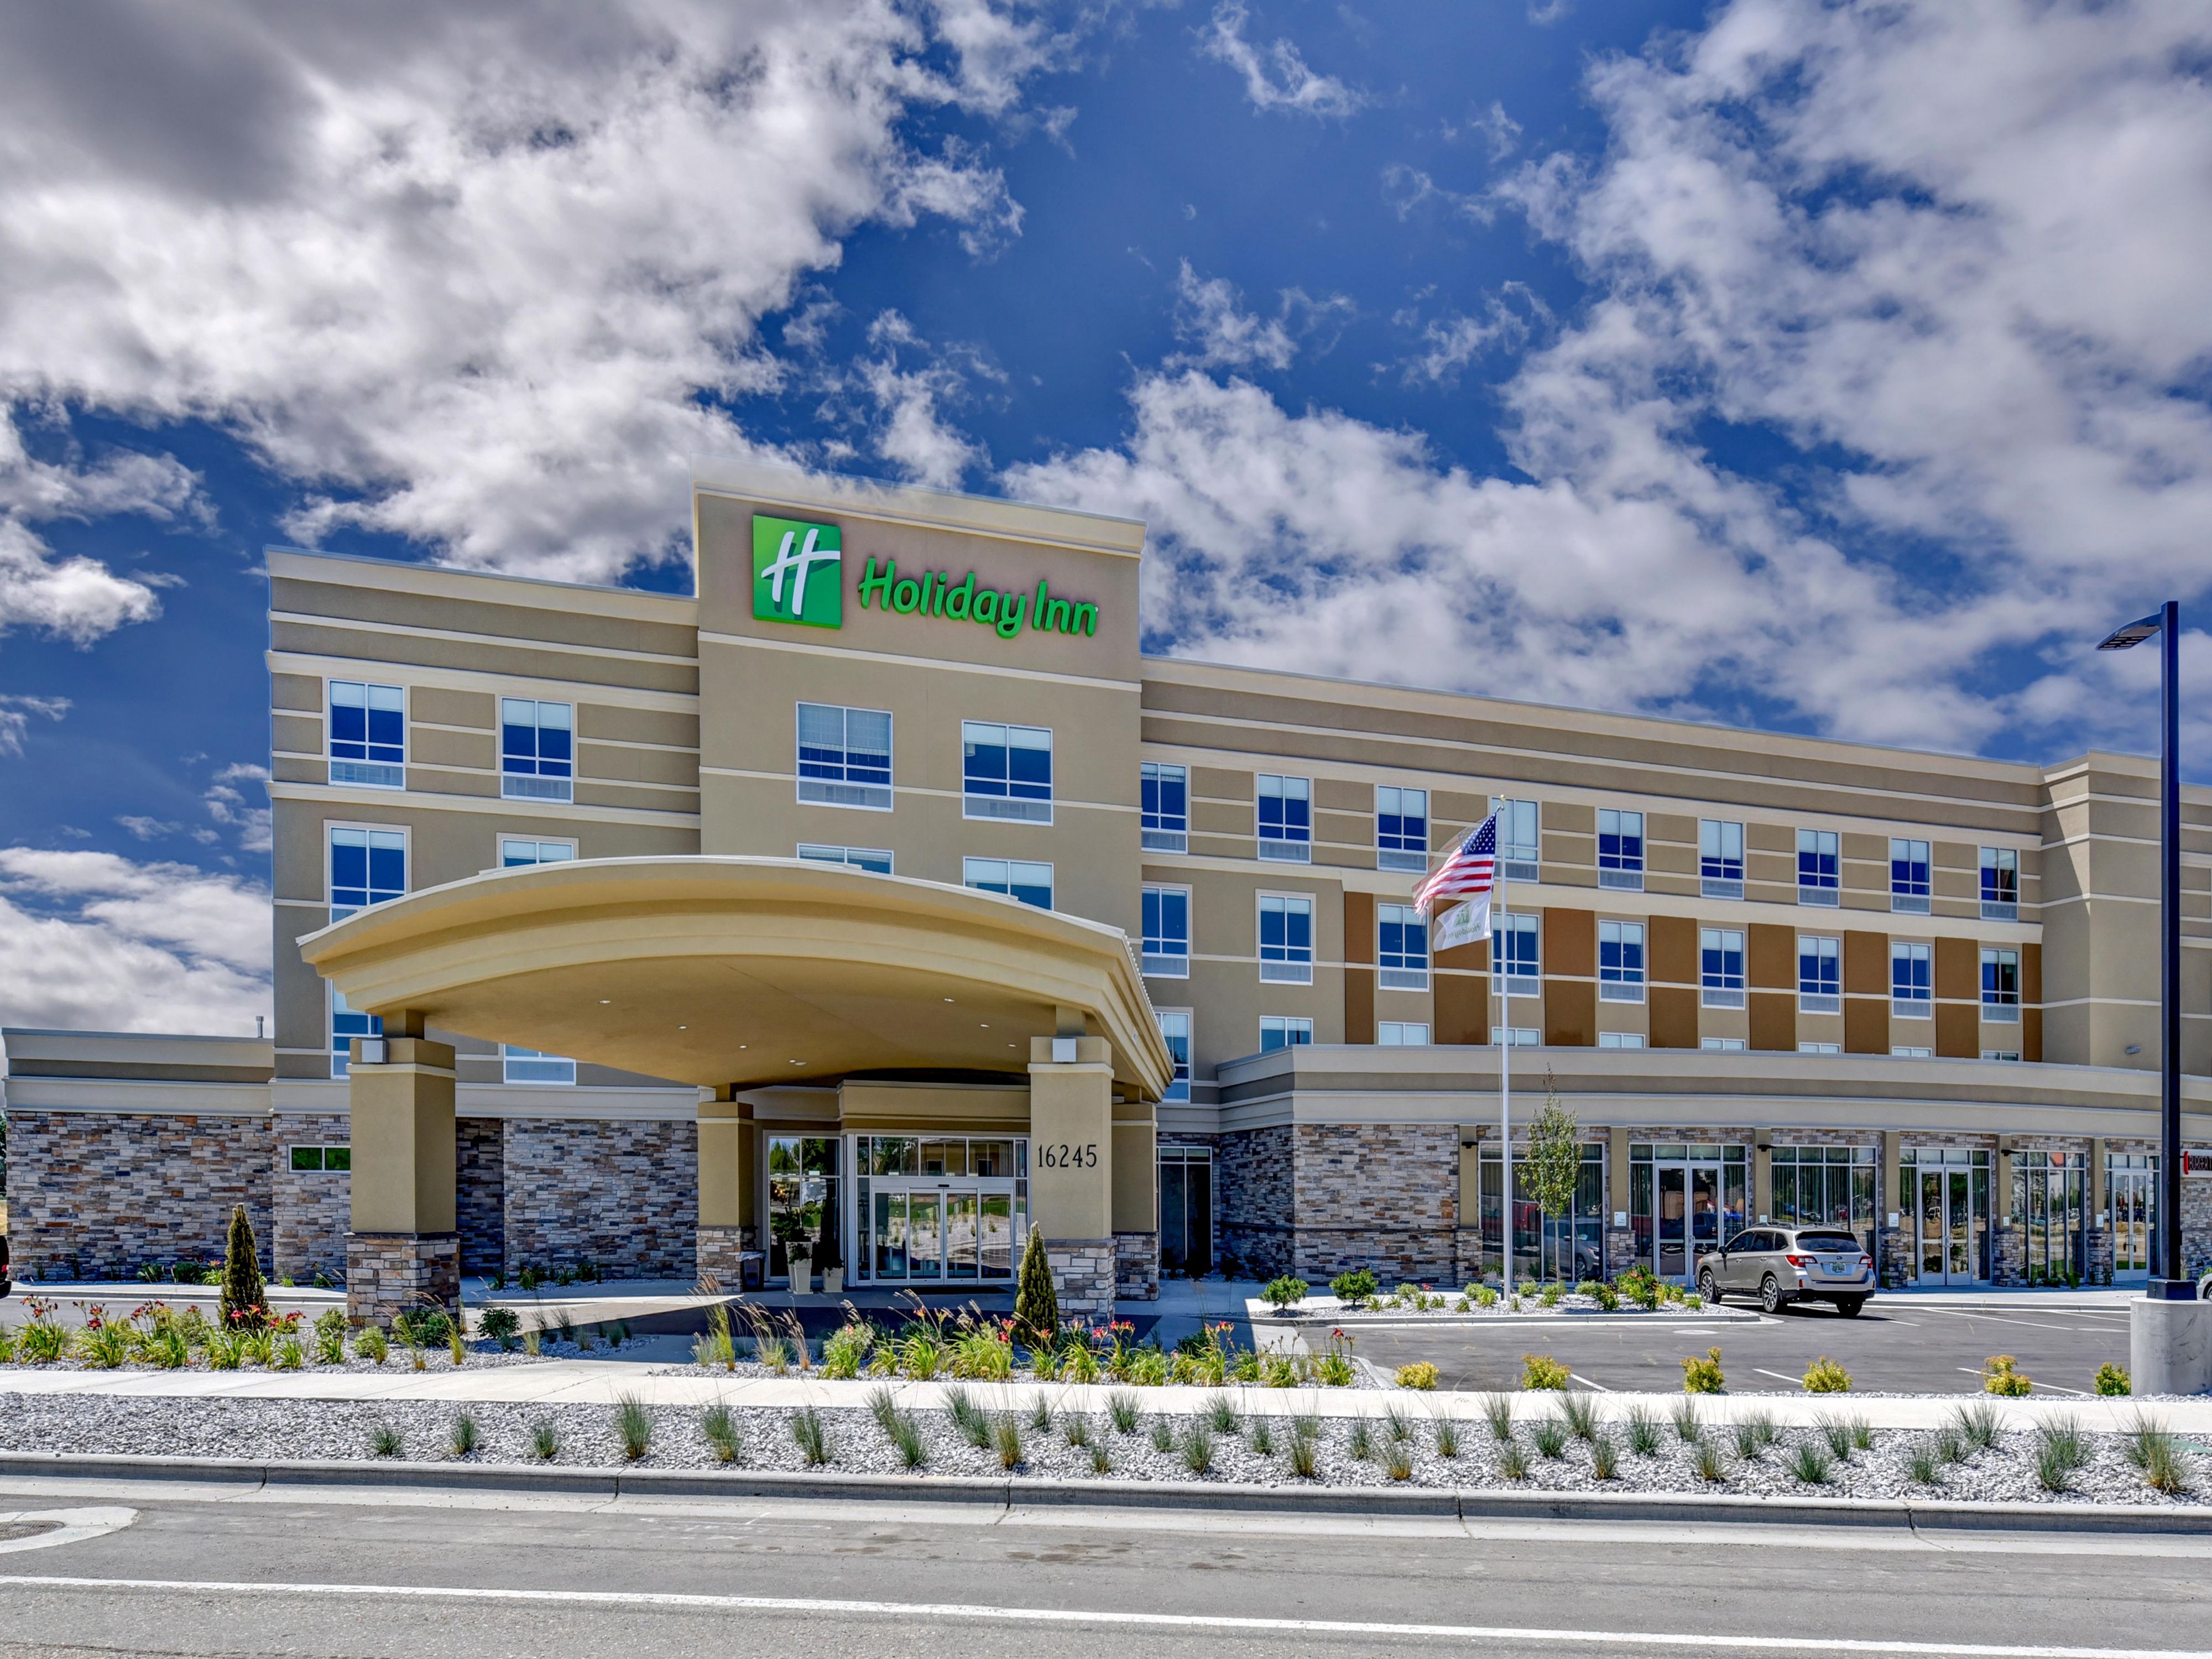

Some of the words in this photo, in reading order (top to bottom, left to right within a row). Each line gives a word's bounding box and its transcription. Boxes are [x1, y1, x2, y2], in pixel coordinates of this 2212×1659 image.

[858, 557, 1026, 639] Holiday
[1032, 580, 1098, 637] Inn
[1038, 1144, 1097, 1168] 16245
[2189, 1155, 2208, 1171] BURGER
